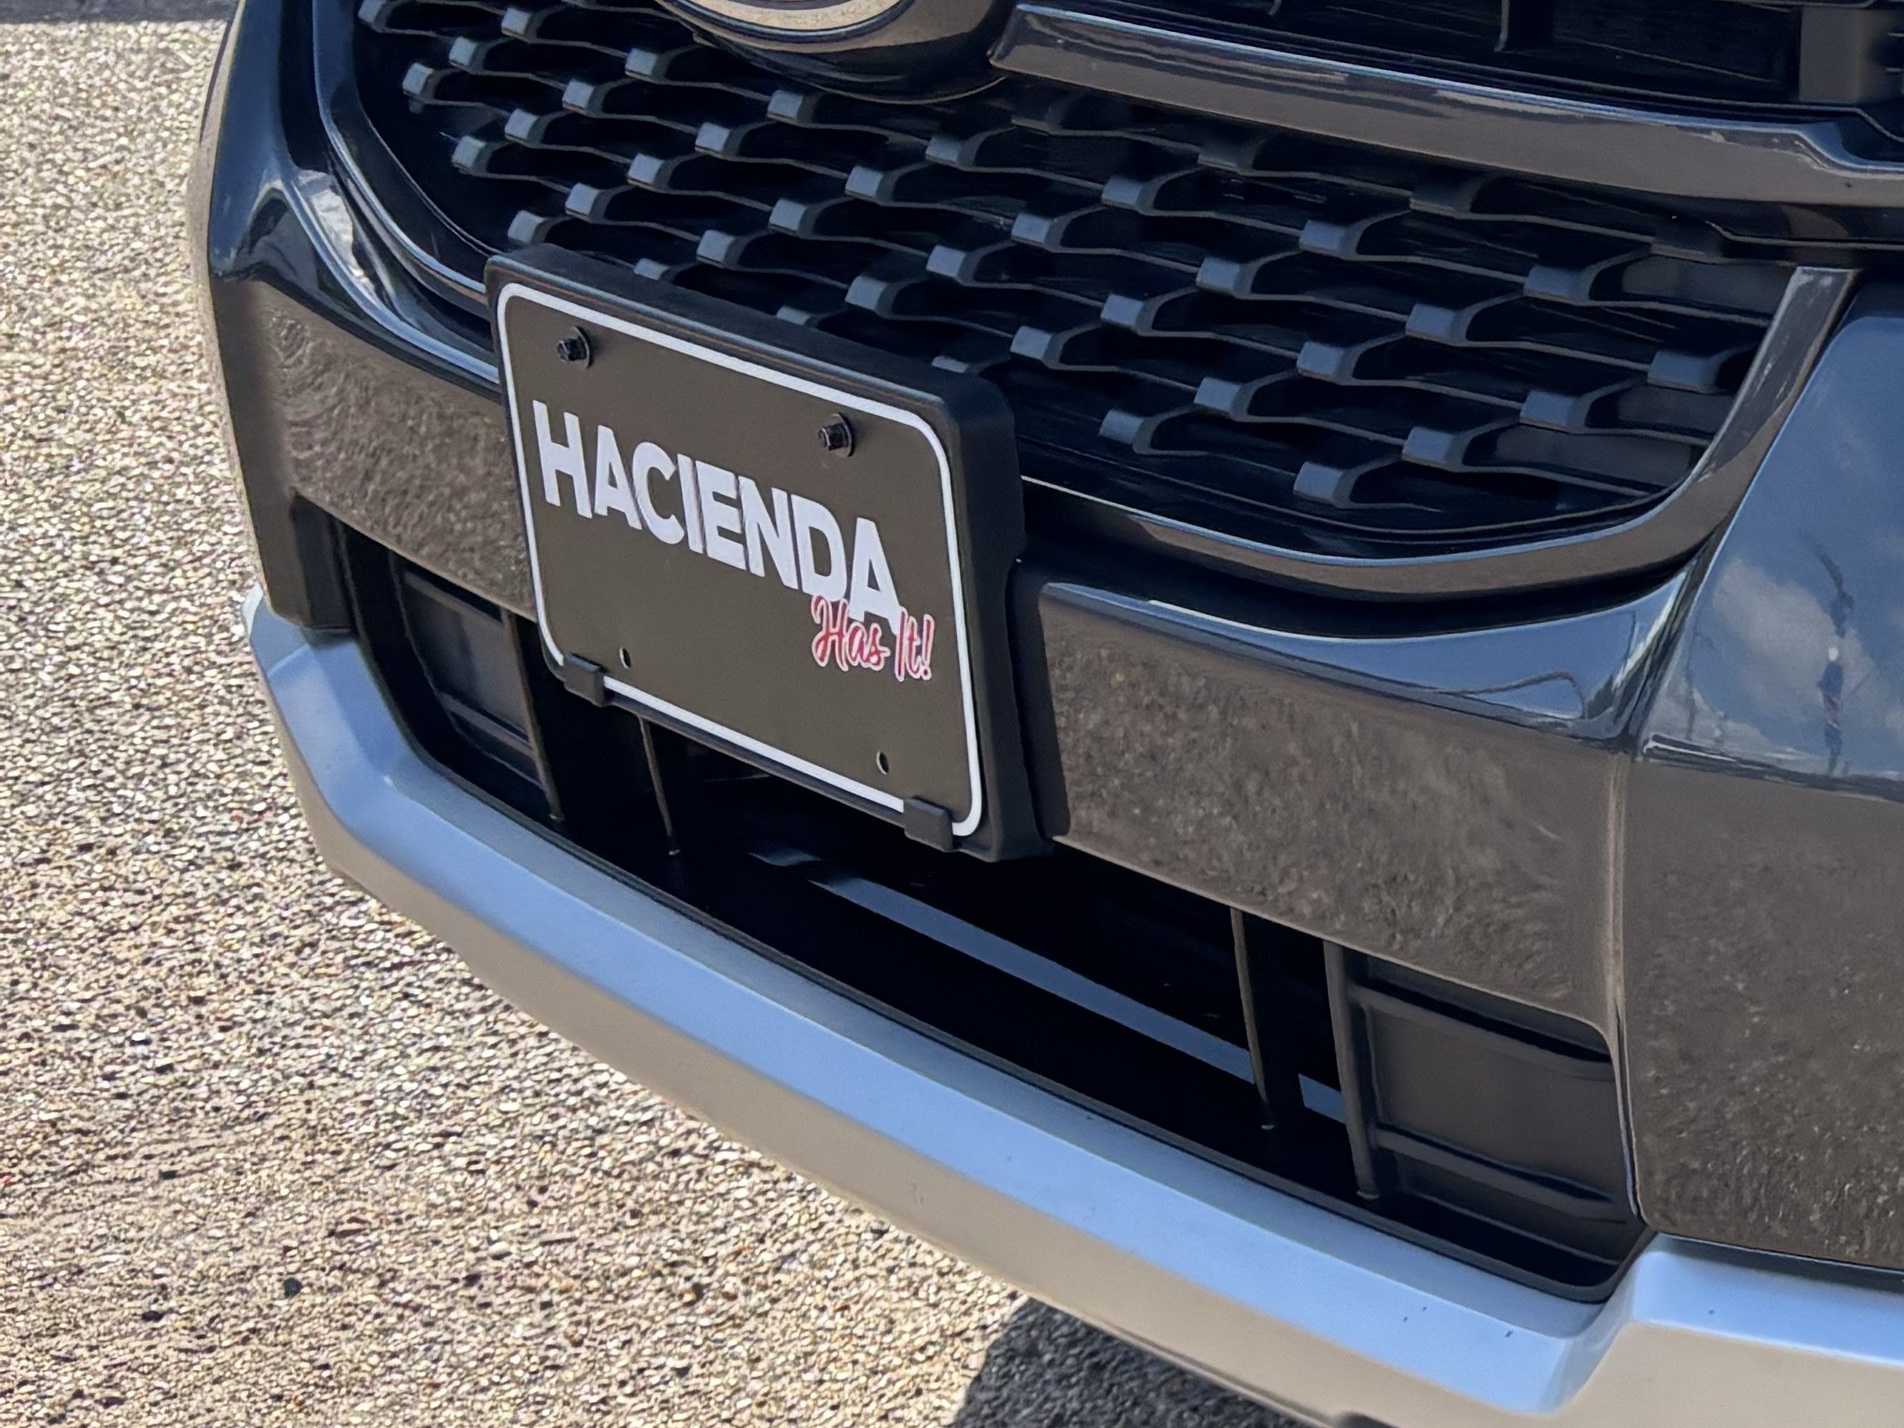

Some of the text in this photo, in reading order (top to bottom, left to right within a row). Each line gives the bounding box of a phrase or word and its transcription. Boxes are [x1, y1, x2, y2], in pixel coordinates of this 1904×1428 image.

[532, 399, 899, 635] HACIENDA
[811, 594, 935, 683] Has It!
